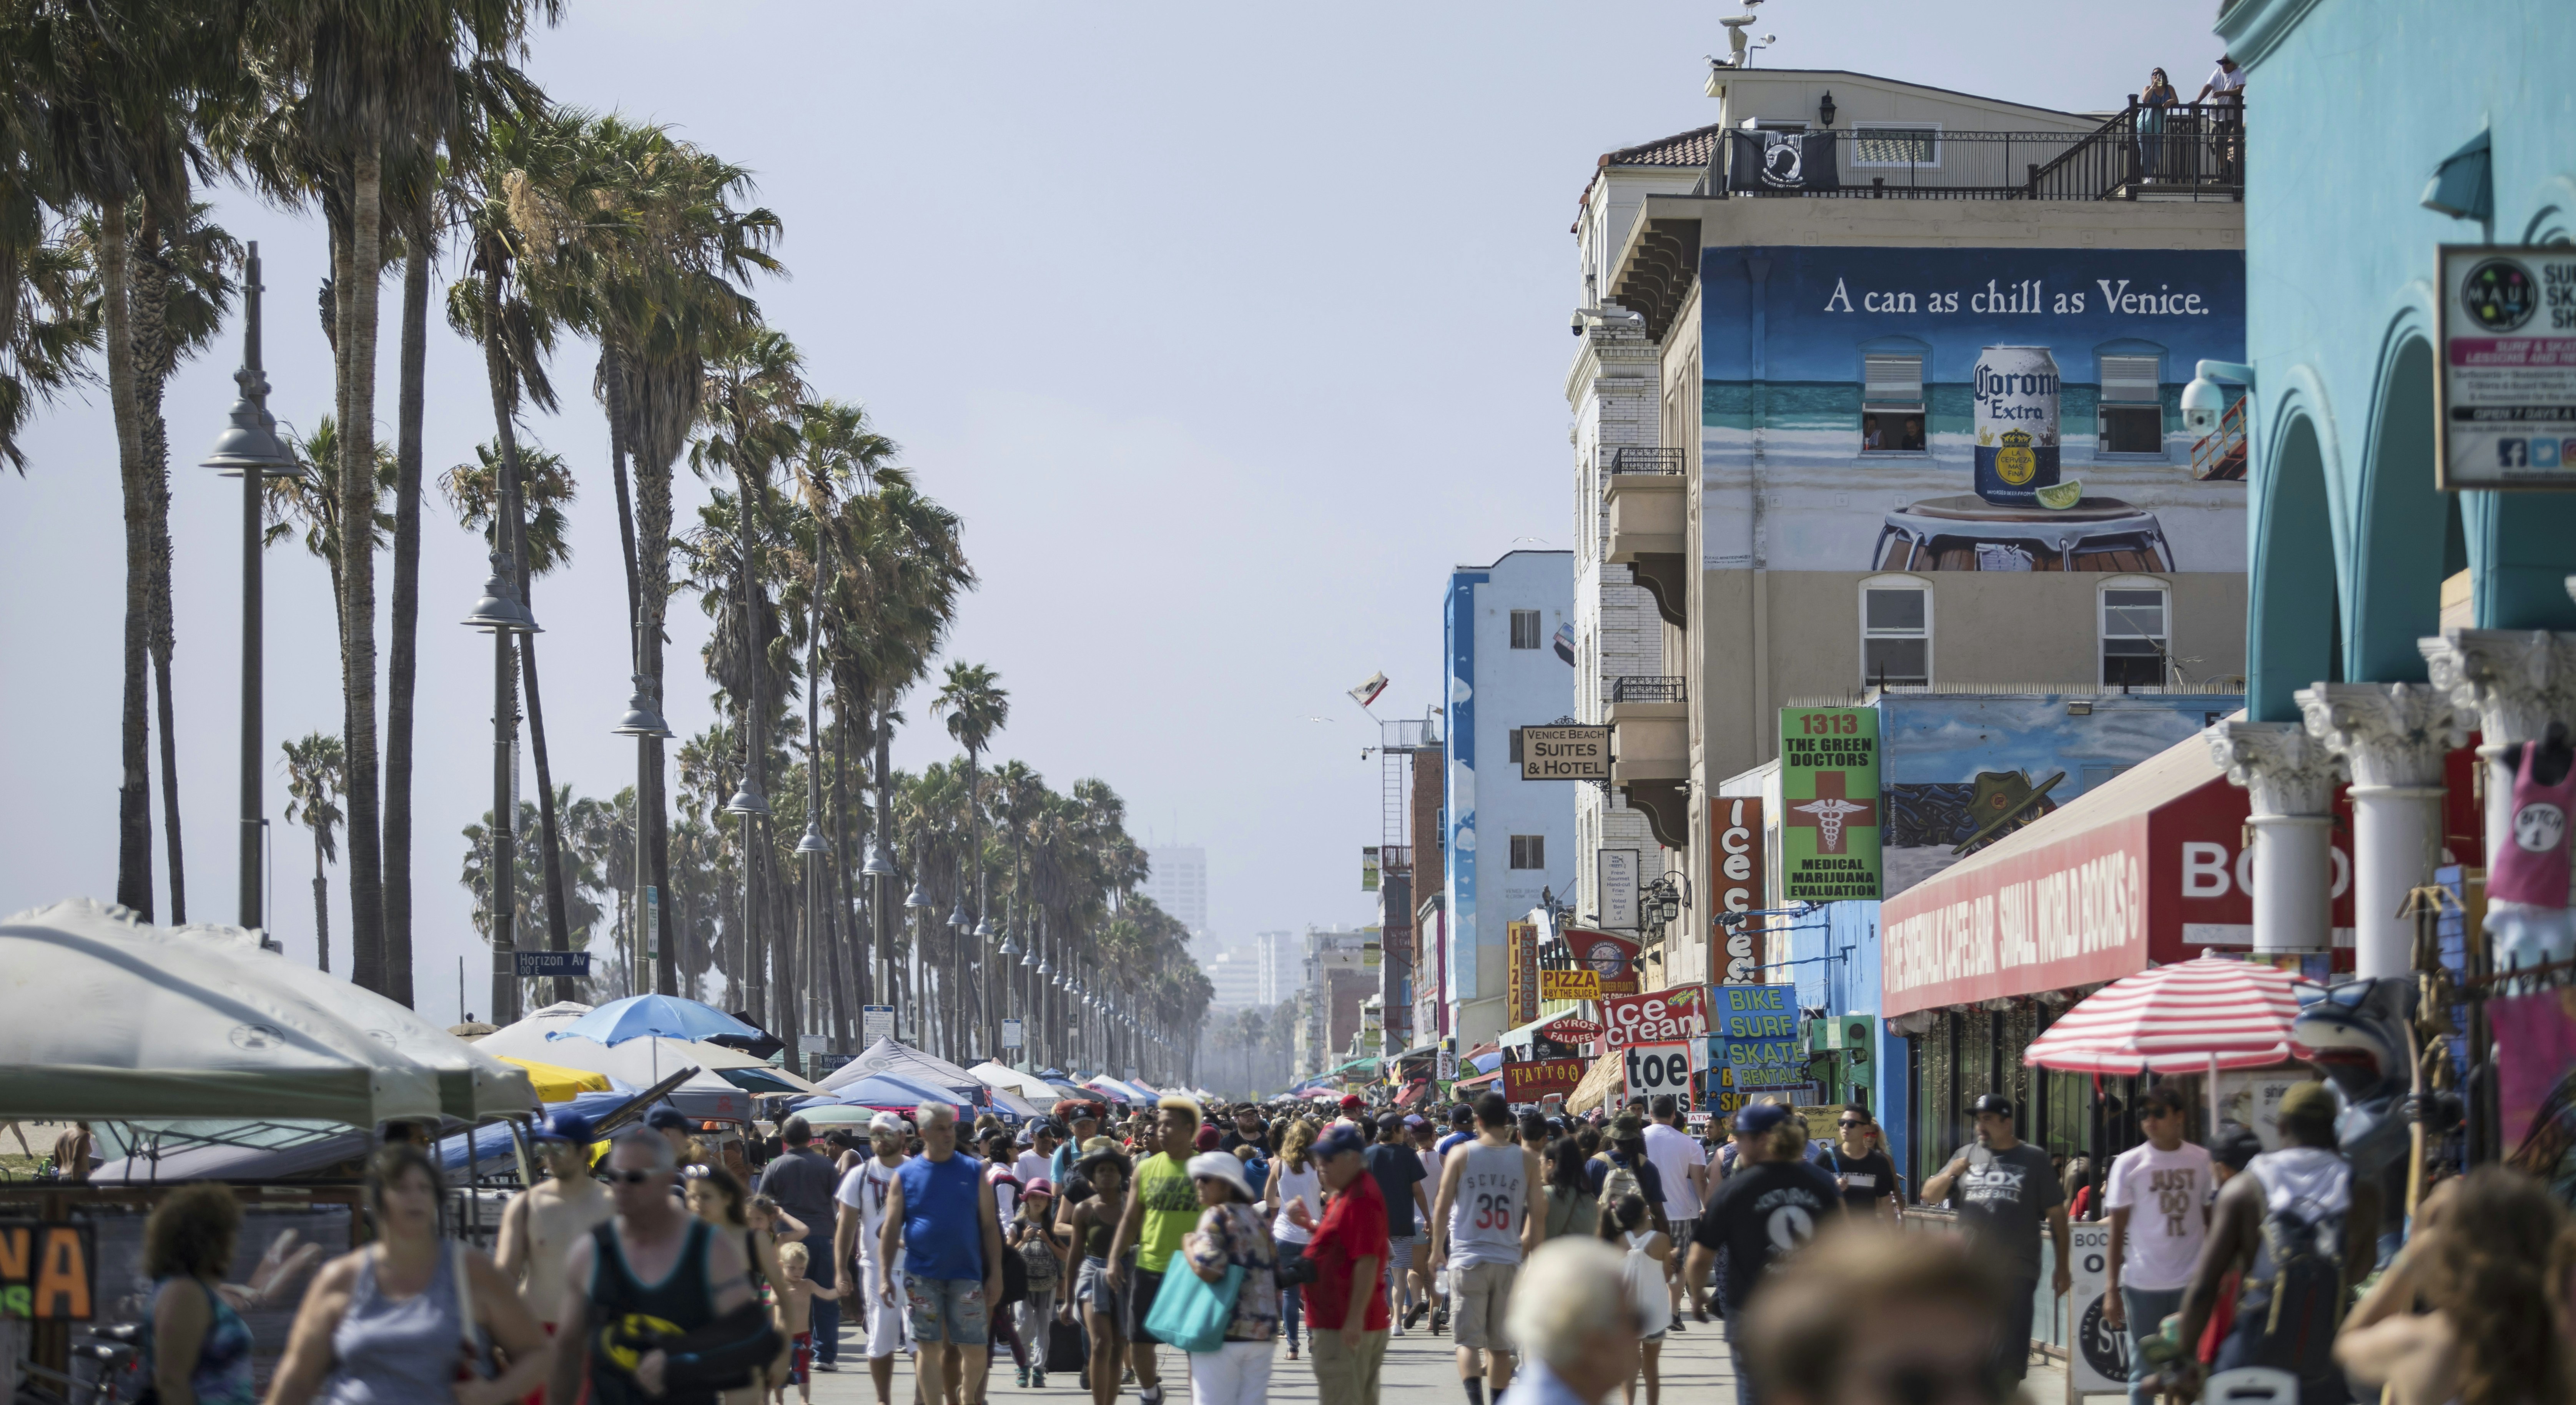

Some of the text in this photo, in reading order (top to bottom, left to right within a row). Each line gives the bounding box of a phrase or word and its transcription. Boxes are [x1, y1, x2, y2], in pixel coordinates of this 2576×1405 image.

[1764, 131, 1802, 158] POW MIA
[1824, 278, 2209, 314] A can as chill as Venice.
[2467, 285, 2533, 303] MAUI
[2546, 286, 2576, 306] SK
[1990, 399, 2044, 420] Extra
[1799, 714, 1858, 734] 1313
[1527, 730, 1605, 739] VENICE BEACH
[1535, 742, 1597, 756] SUITES
[1786, 738, 1872, 752] THE GREEN
[1528, 760, 1605, 774] & HOTEL
[1791, 753, 1869, 766] DOCTORS
[1801, 859, 1864, 870] MEDICAL
[1792, 872, 1874, 883] MARIJUANA
[1791, 885, 1876, 896] EVALUATION
[1889, 922, 1903, 994] THE
[1904, 907, 1944, 990] SIDEWALK
[1999, 880, 2036, 969] SMALL
[2037, 867, 2079, 964] WORLD
[2080, 849, 2126, 953] BOOKS
[1591, 942, 1621, 954] AMERICAN
[520, 954, 585, 966] Horizon Av
[520, 966, 540, 975] 00 E
[1521, 931, 1535, 1017] INDIGENOUS
[1543, 972, 1596, 987] PIZZA
[1617, 981, 1634, 991] FLOATS
[1549, 989, 1592, 997] BY THE SLICE
[1668, 989, 1688, 1005] CHARLY
[1728, 989, 1784, 1011] BIKE
[1604, 1000, 1666, 1028] ice
[1553, 1019, 1596, 1030] GYROS
[1606, 1014, 1706, 1045] cream
[1730, 1015, 1793, 1037] SURF
[1550, 1032, 1598, 1043] FALAFEL
[1730, 1042, 1808, 1065] SKATE
[1626, 1045, 1688, 1088] toe
[1511, 1064, 1579, 1087] TATTOO
[1741, 1067, 1802, 1086] RENTALS
[1517, 1085, 1575, 1100] PIERCINGS
[1815, 1124, 1824, 1135] of
[1467, 1174, 1519, 1190] SCVLE
[1965, 1172, 2026, 1187] SOX
[2149, 1168, 2196, 1192] JUST
[1965, 1190, 2020, 1203] BASEBALL
[2159, 1192, 2189, 1214] DO
[1475, 1193, 1510, 1230] 36
[2074, 1233, 2129, 1247] BOOS
[2082, 1303, 2100, 1339] SMALL
[2107, 1368, 2128, 1379] VEN
